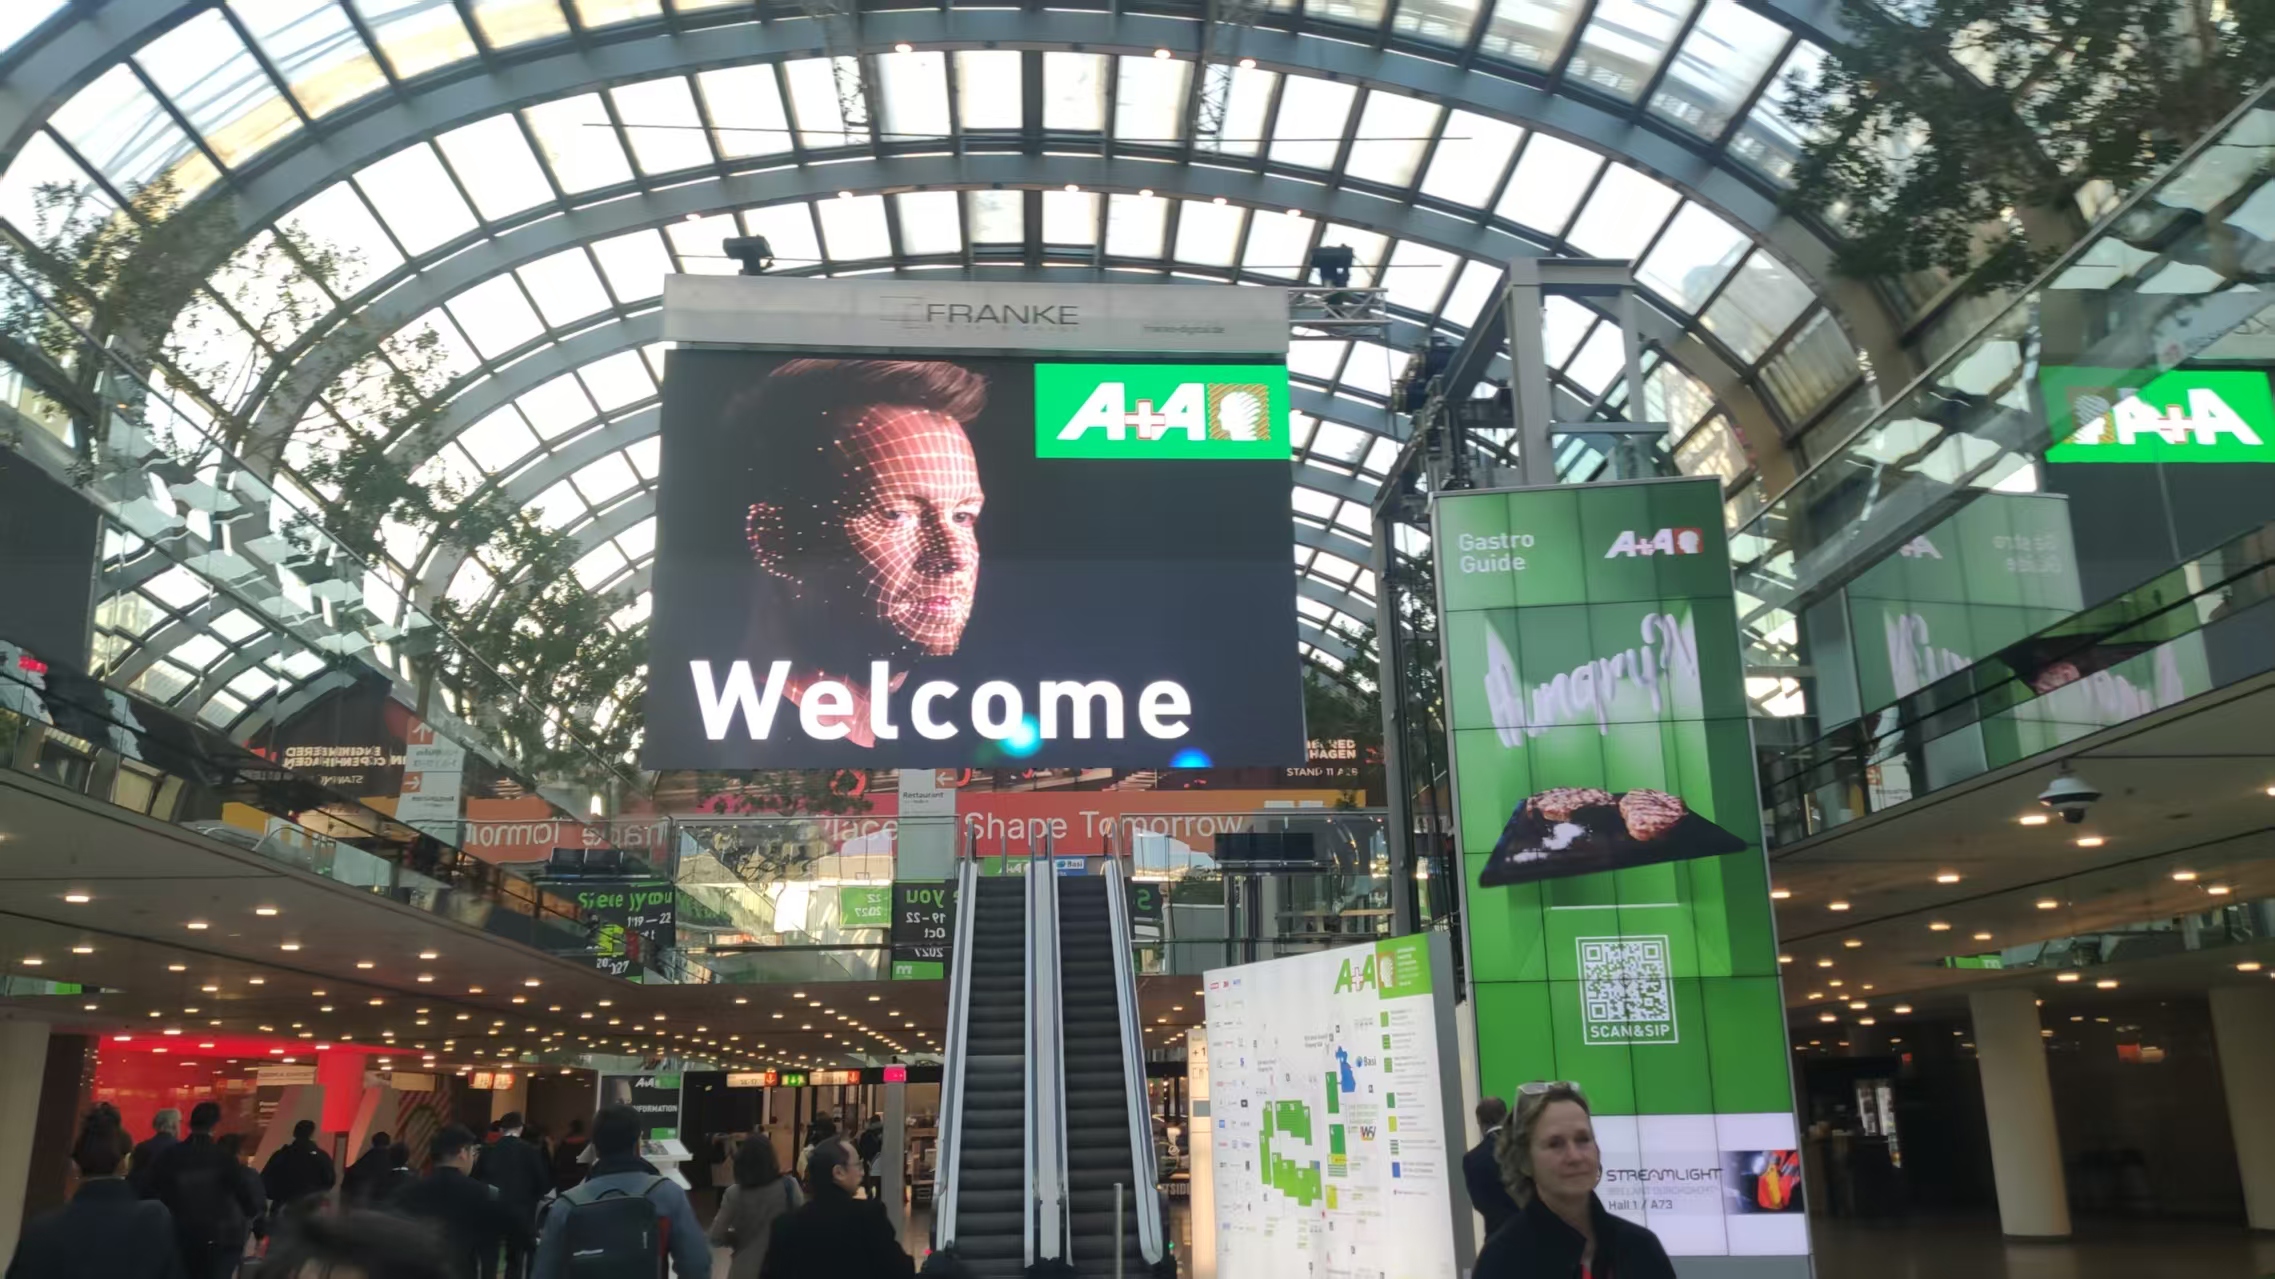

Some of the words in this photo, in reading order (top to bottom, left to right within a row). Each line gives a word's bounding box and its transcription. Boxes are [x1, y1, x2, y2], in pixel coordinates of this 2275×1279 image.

[925, 303, 1080, 326] FRANKE
[1056, 382, 1205, 441] A+A
[1458, 531, 1536, 553] Gastro
[1604, 528, 1674, 559] A+A
[1459, 554, 1528, 574] Guide
[690, 659, 1193, 742] Welcome
[902, 791, 945, 799] Restaurant
[964, 811, 1068, 847] Shape
[1079, 810, 1244, 839] Tomorrow
[1333, 954, 1377, 995] A+A
[1589, 1023, 1671, 1039] SCAN&SIP
[1606, 1168, 1724, 1182] STREAMLIGHT
[1608, 1200, 1630, 1210] Hall
[1650, 1199, 1673, 1209] A73
